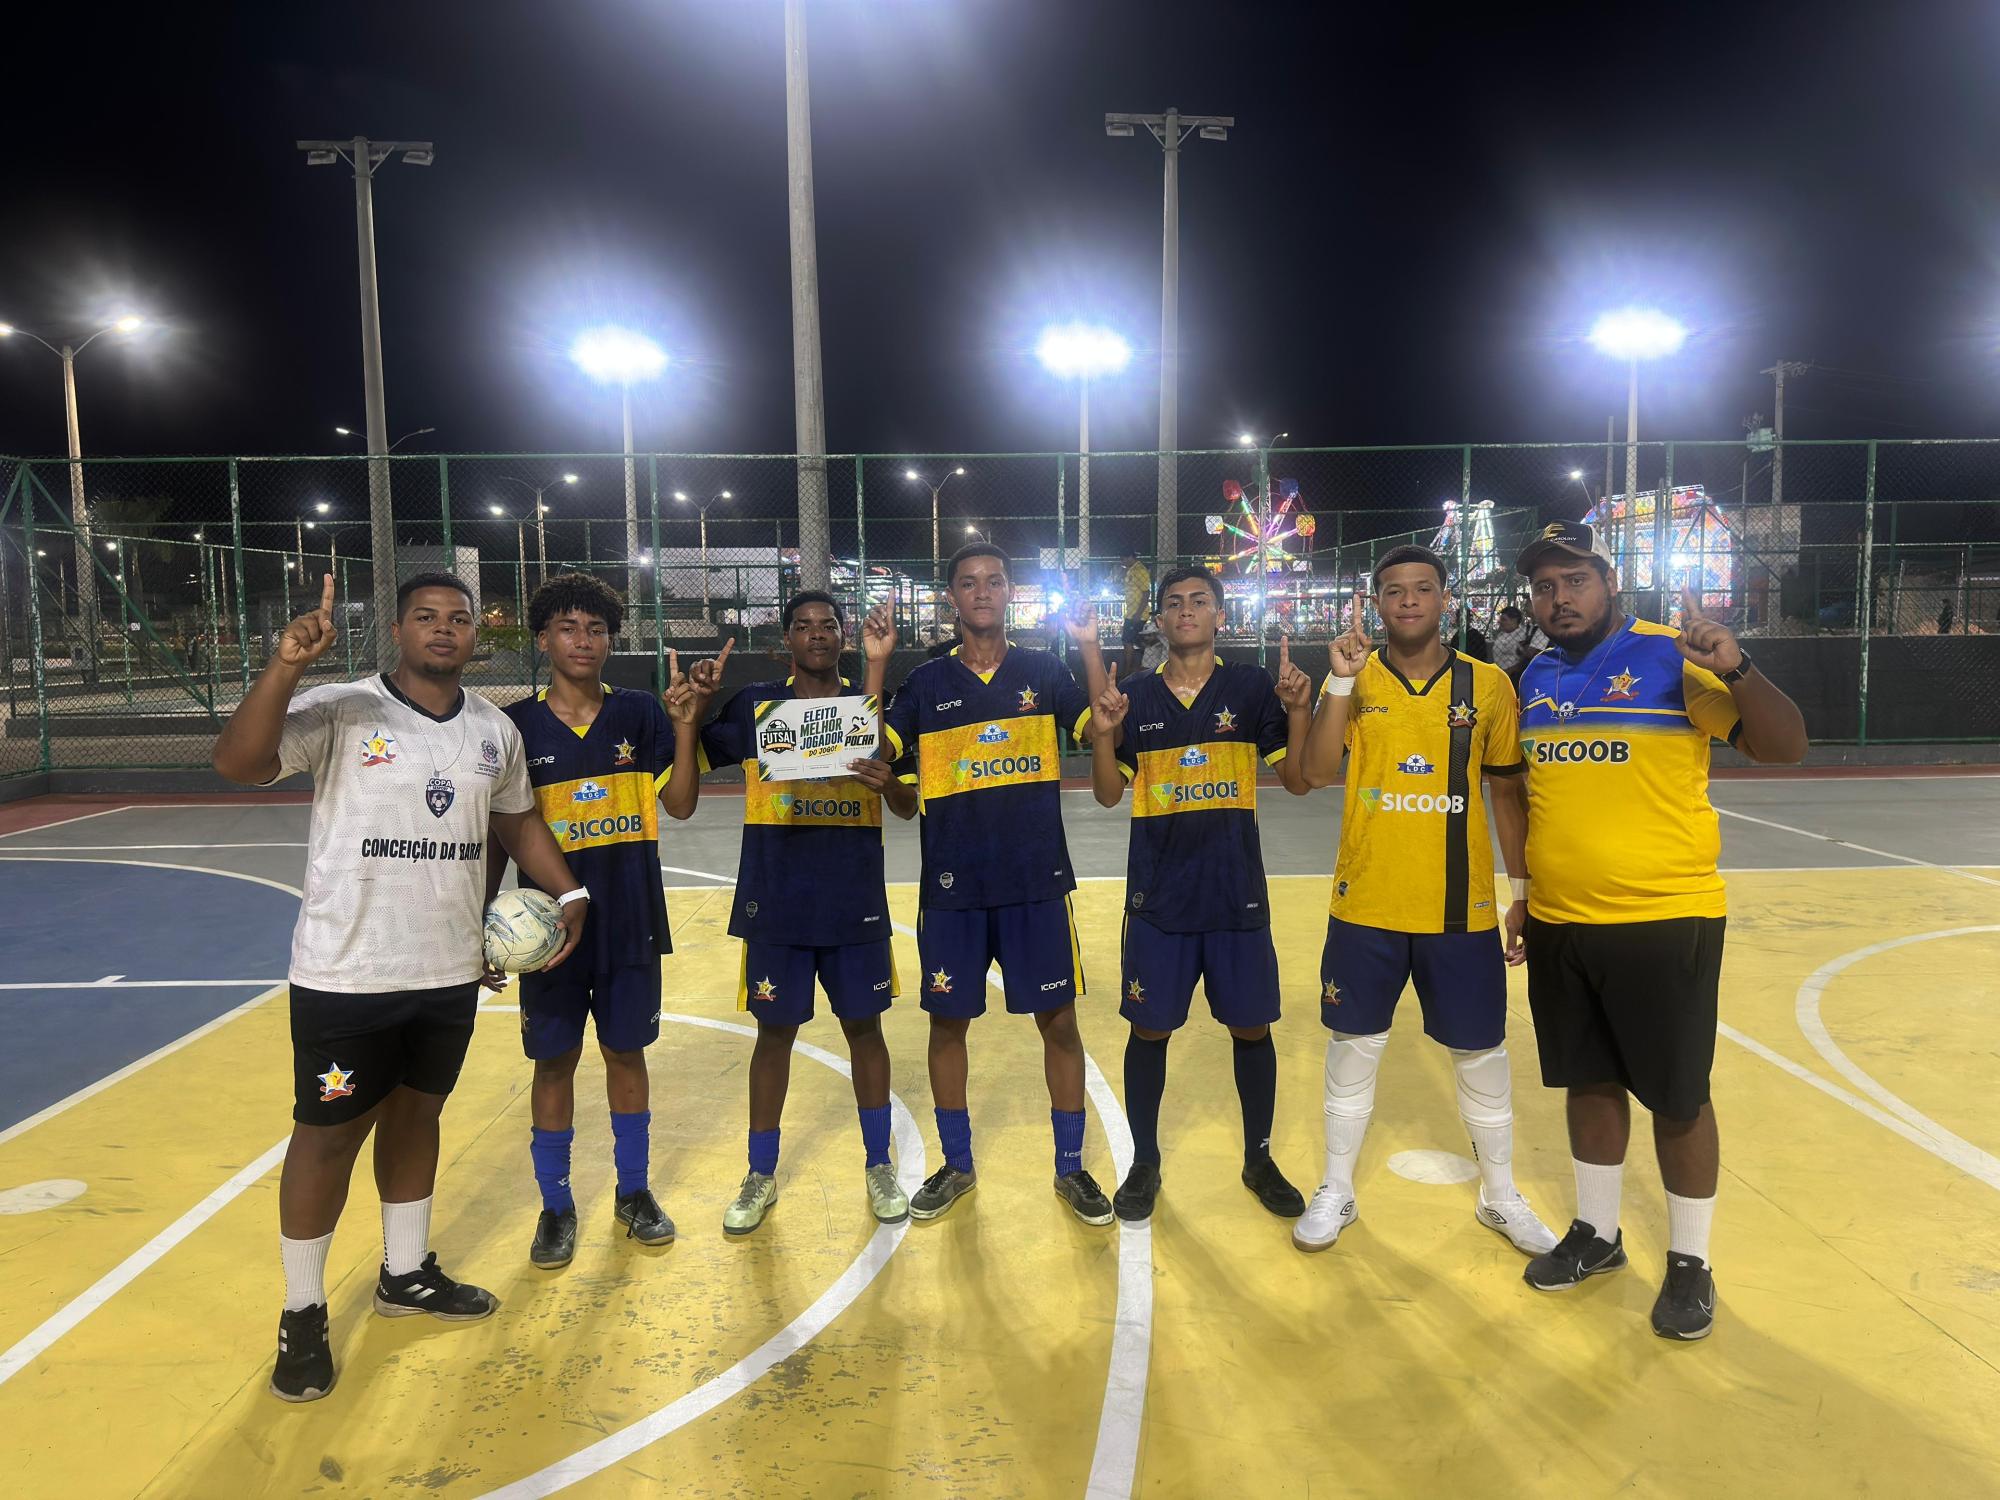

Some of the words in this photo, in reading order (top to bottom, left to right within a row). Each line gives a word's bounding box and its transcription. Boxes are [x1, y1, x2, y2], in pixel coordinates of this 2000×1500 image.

[803, 706, 838, 724] ELEITO
[799, 717, 843, 738] MELHOR
[761, 731, 797, 747] FUTSAL
[799, 731, 844, 751] JOGADOR
[808, 749, 818, 758] DO
[818, 744, 838, 756] JOGO!
[1536, 740, 1630, 763] SICOOB
[970, 755, 1041, 779] SICOOB
[429, 778, 453, 789] COPA
[1174, 781, 1239, 803] SICOOB
[793, 799, 861, 817] SICOOB
[1381, 792, 1465, 814] SICOOB
[568, 814, 643, 841] SICOOB
[361, 837, 437, 864] CONCEIÇÃO
[440, 841, 457, 861] DA
